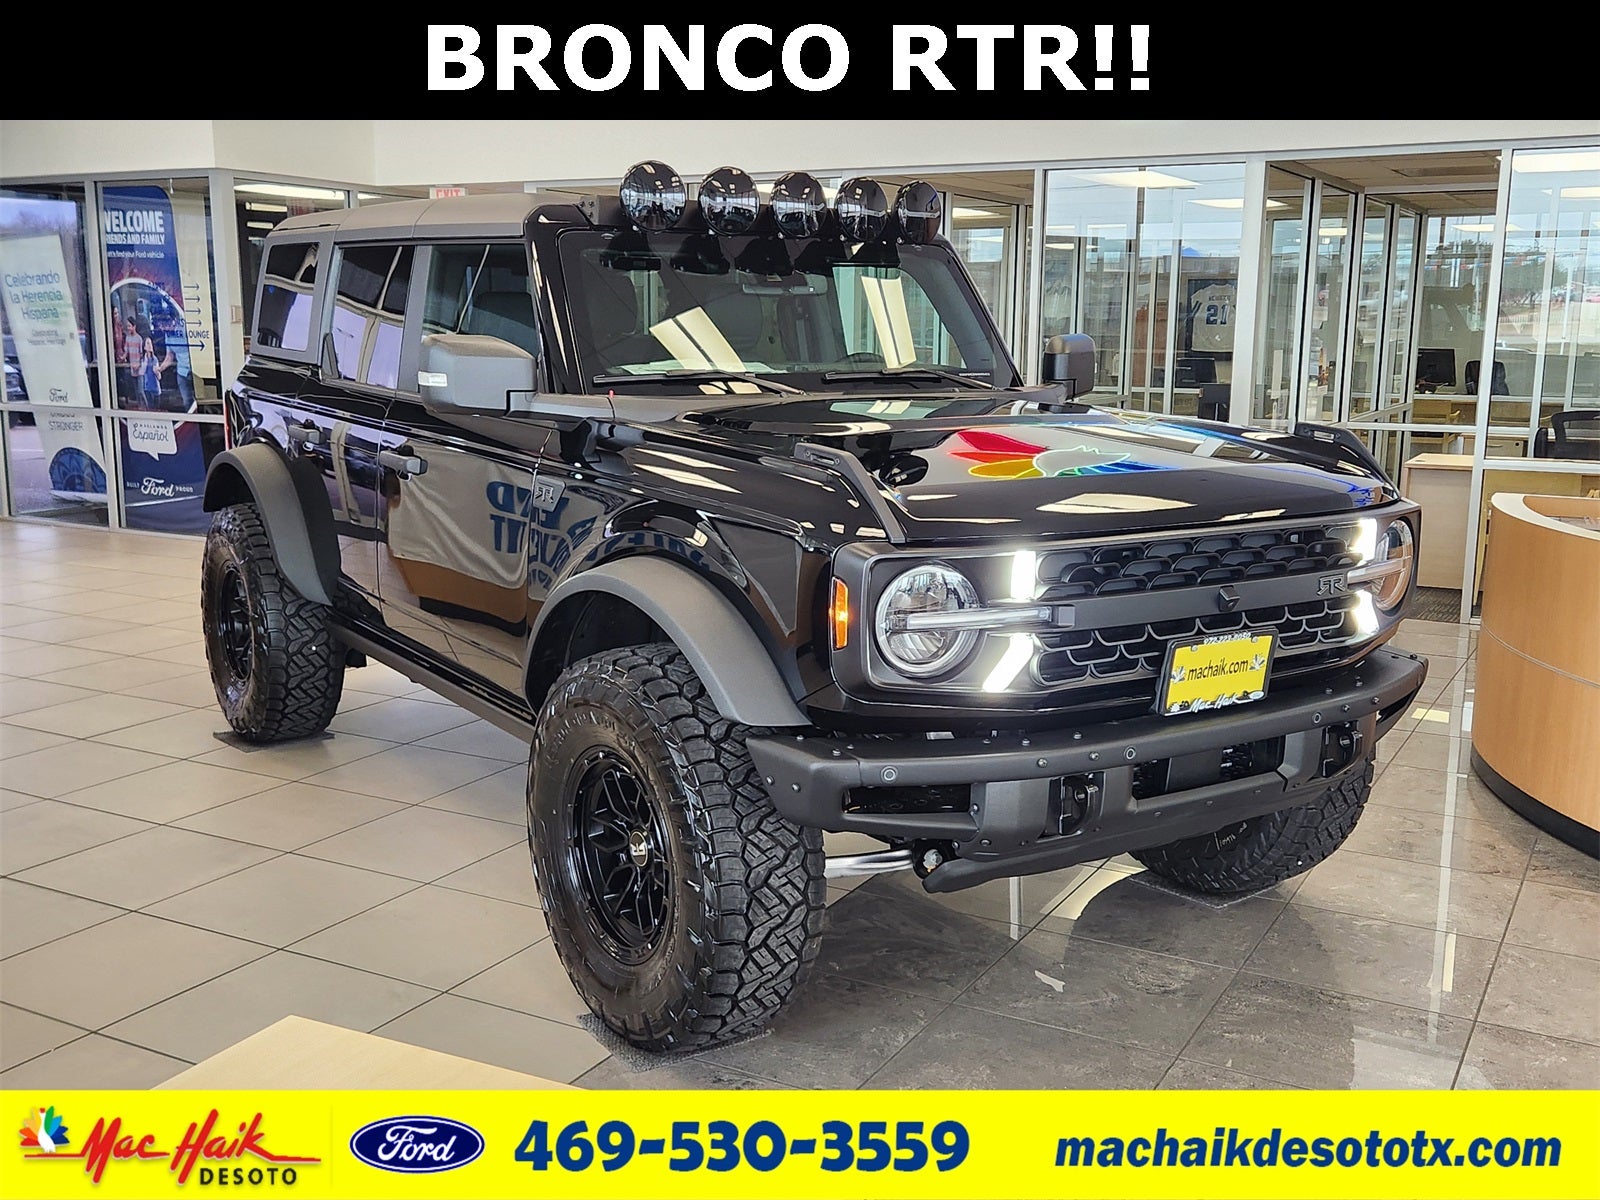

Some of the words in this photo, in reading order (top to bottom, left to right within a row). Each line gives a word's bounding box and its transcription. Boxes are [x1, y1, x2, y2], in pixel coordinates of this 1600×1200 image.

[127, 234, 140, 245] AND
[141, 233, 165, 245] FAMILY
[4, 271, 60, 288] Celebrando
[141, 477, 175, 497] Ford
[1187, 658, 1249, 681] machaik.com
